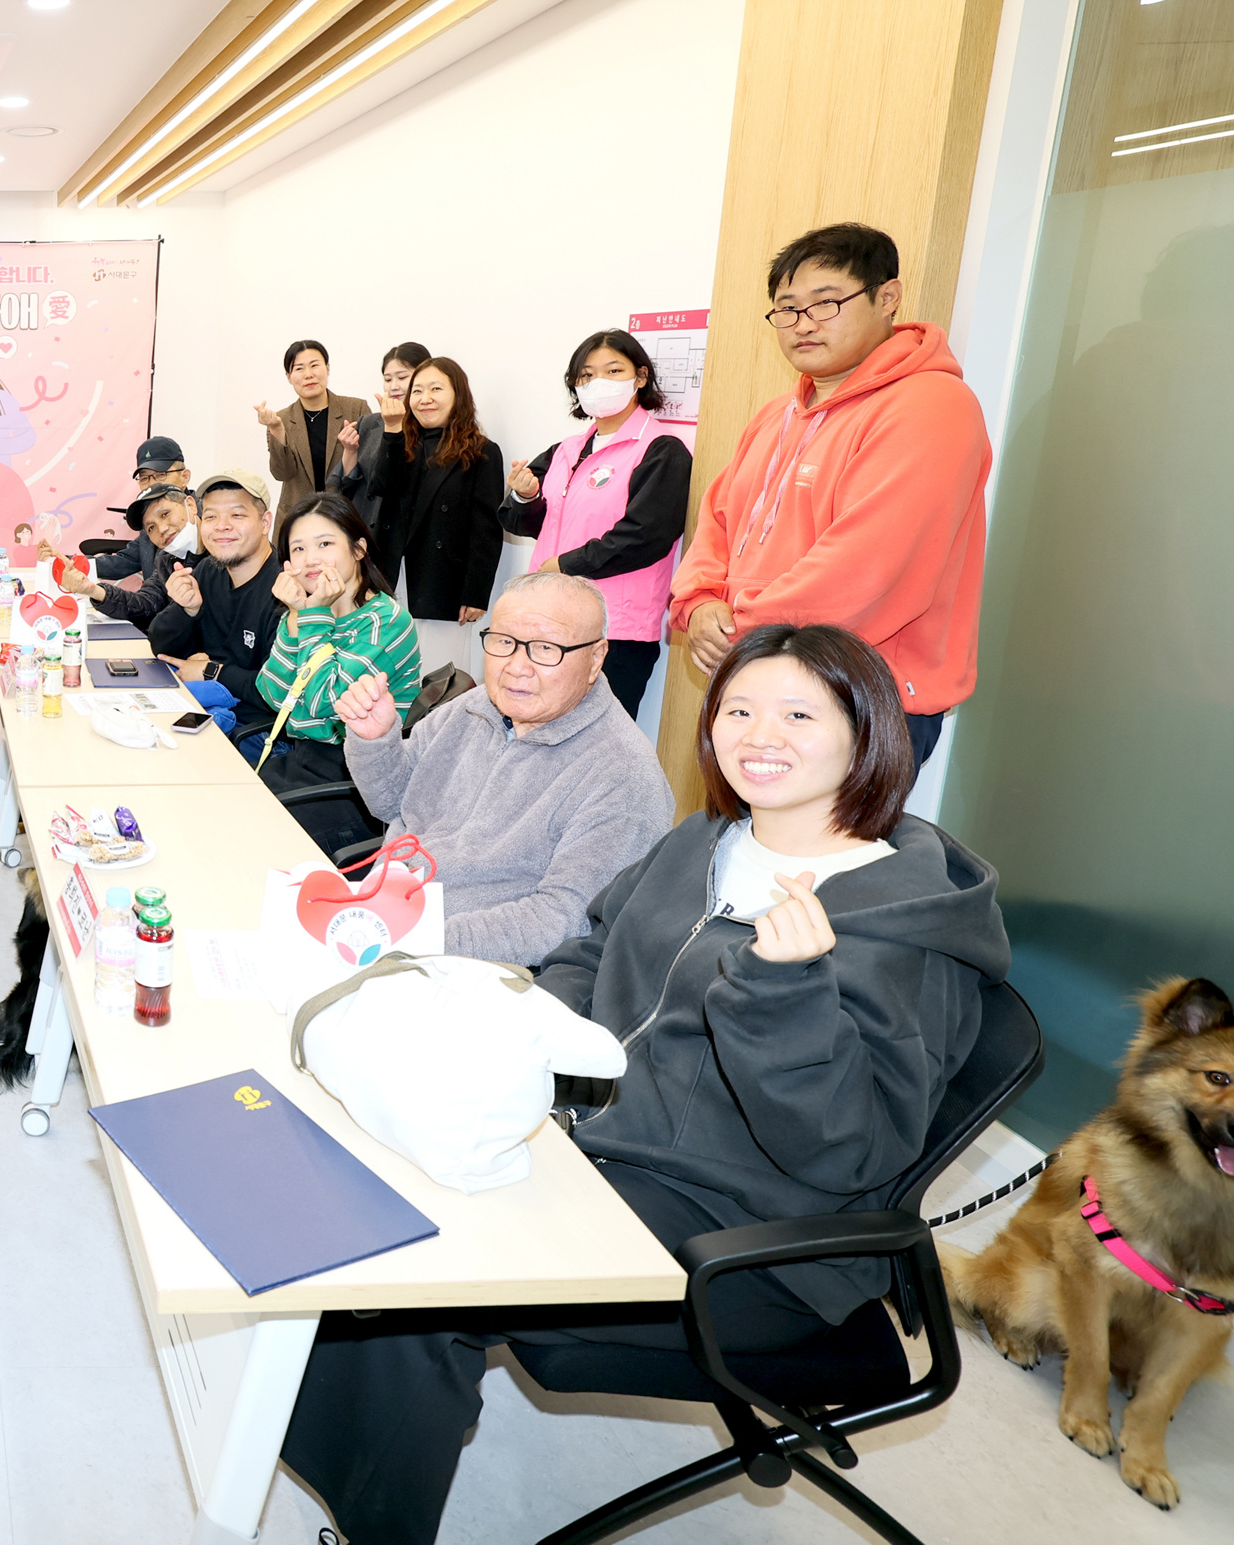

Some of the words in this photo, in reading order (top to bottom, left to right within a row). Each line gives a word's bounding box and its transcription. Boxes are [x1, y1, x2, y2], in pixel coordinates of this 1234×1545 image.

[48, 294, 70, 320] 愛
[330, 914, 347, 935] 서대문
[374, 921, 388, 937] 센터
